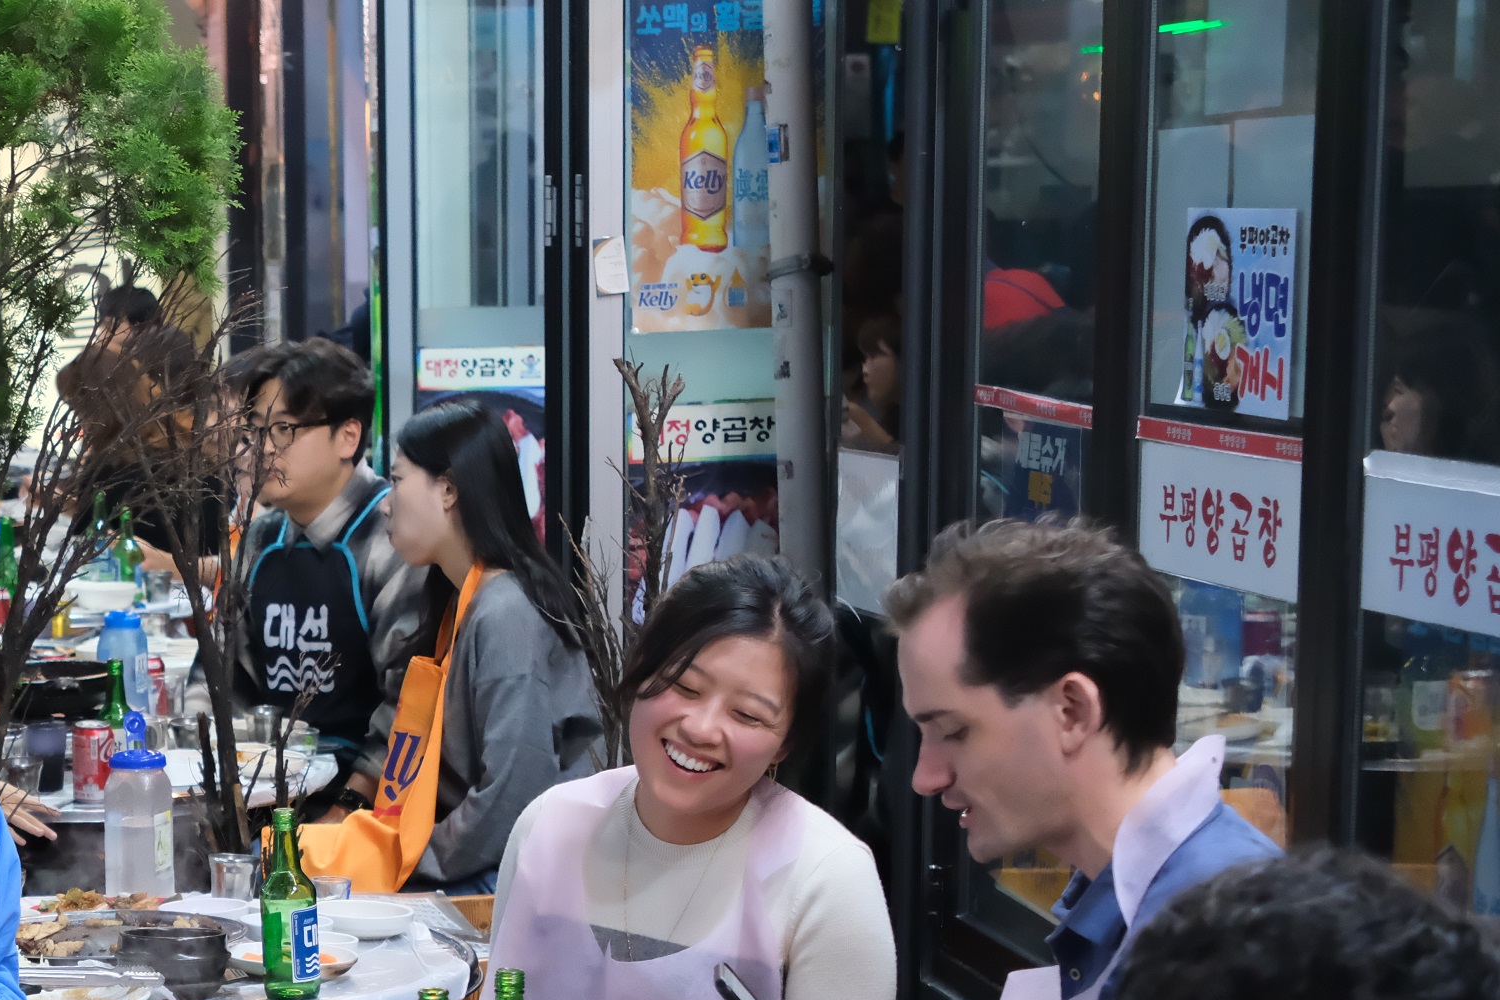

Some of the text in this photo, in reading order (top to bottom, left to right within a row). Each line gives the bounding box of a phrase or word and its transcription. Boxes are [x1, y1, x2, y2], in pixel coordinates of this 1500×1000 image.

[683, 168, 725, 195] Kelly
[1239, 225, 1290, 257] 부평양곱창
[638, 291, 678, 311] Kelly
[1238, 271, 1289, 338] 냉면
[425, 358, 514, 378] 대정양곱창
[1235, 345, 1284, 402] 개시
[1159, 484, 1283, 569] 부평양곱창
[263, 603, 333, 652] 대선
